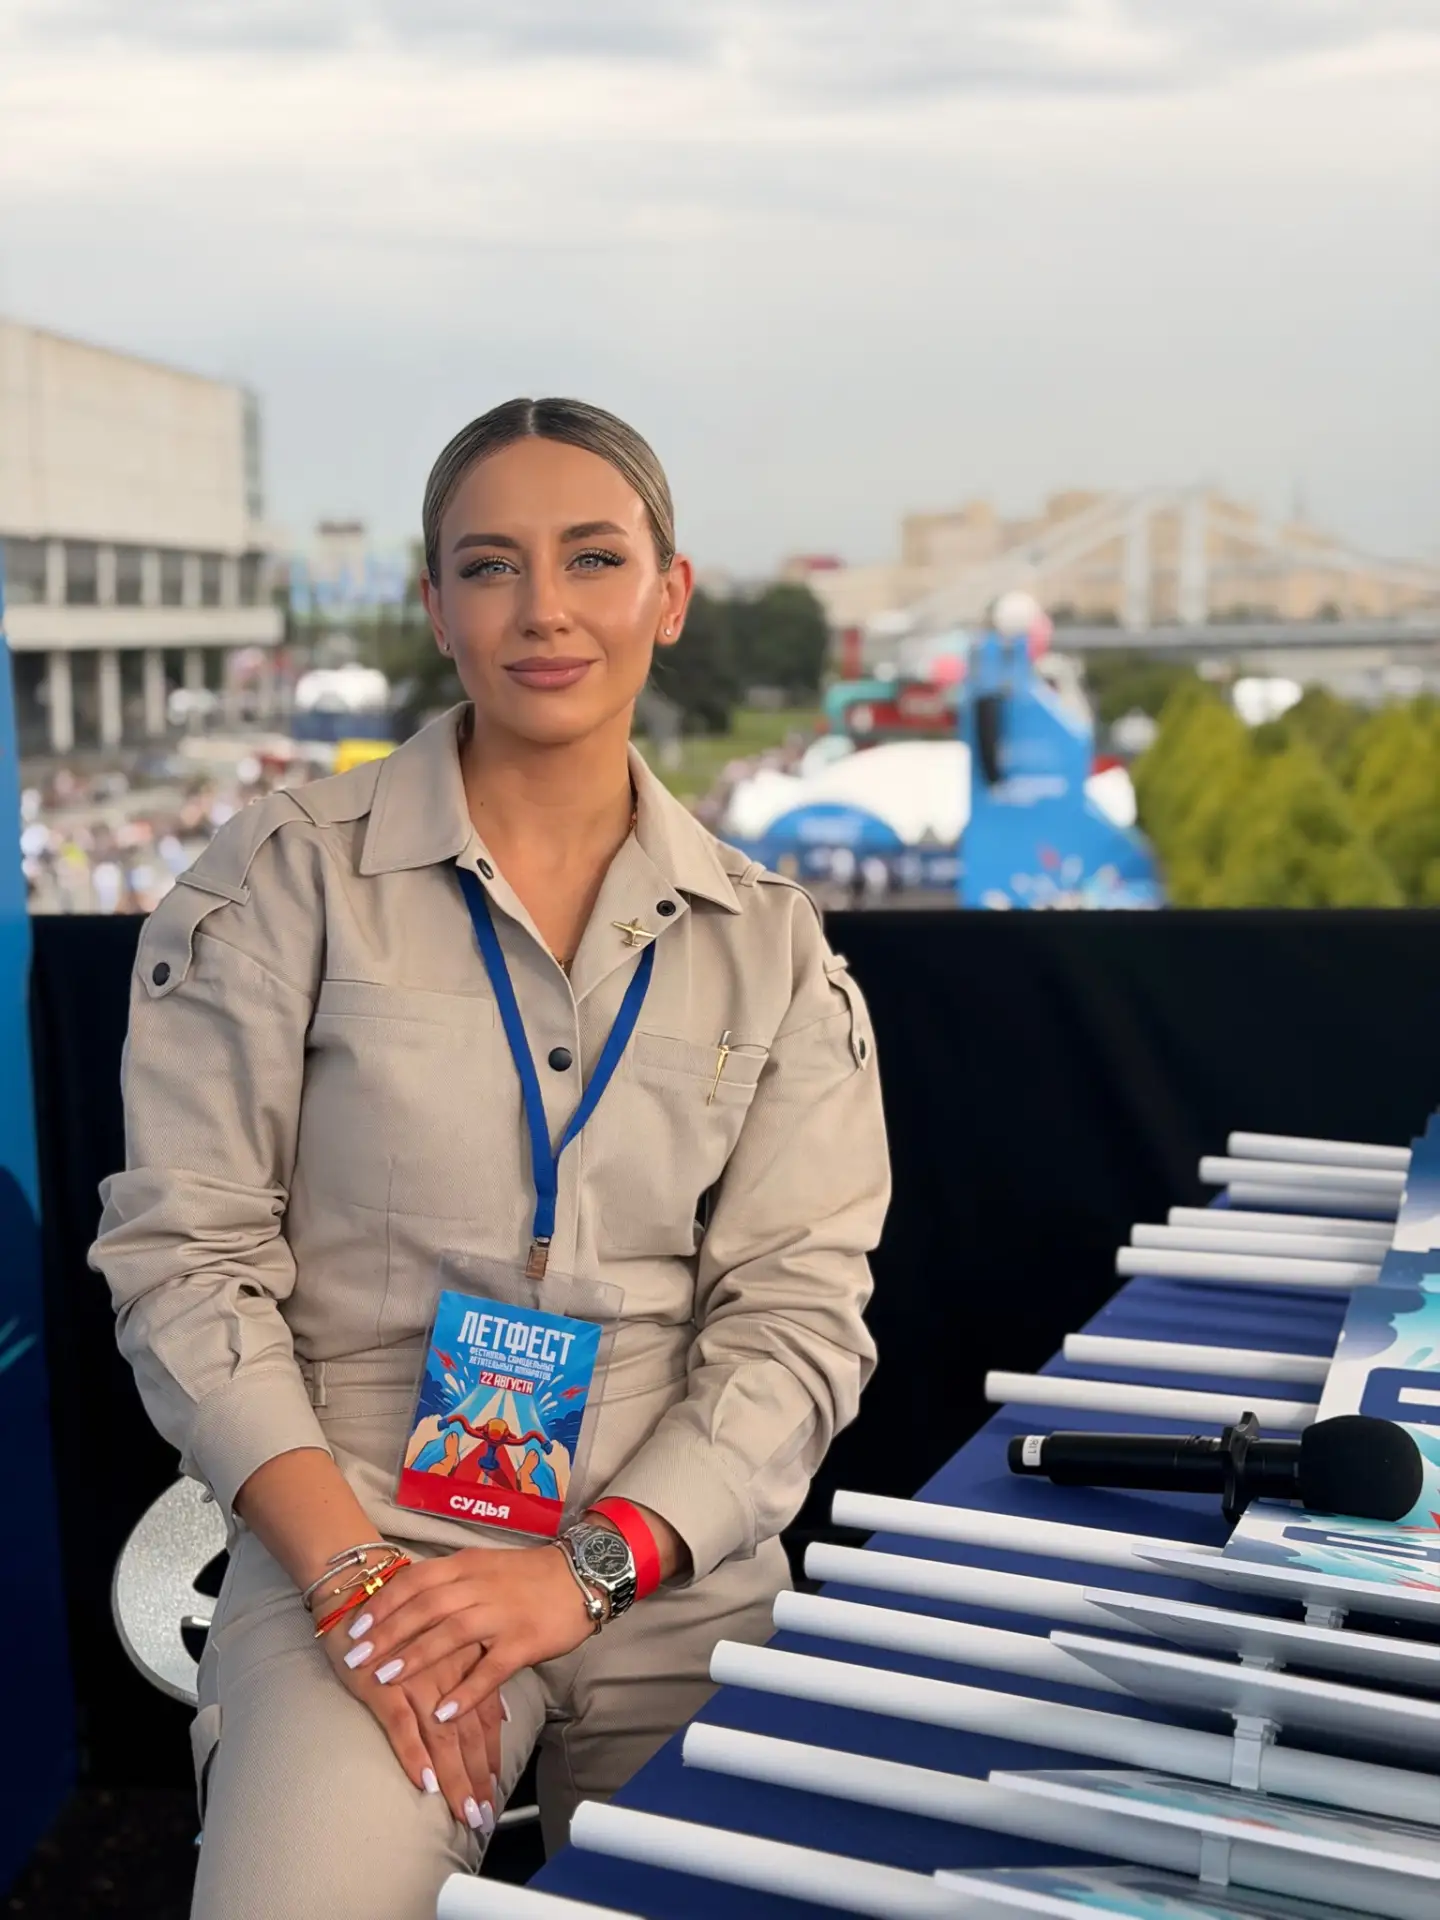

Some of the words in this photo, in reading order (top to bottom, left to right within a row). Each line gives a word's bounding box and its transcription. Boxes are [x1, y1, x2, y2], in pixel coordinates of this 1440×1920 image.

[457, 1310, 576, 1366] ЛЕТФЕСТ
[480, 1371, 493, 1386] 22
[493, 1374, 535, 1394] АВГУСТА
[449, 1494, 511, 1520] СУДЬЯ
